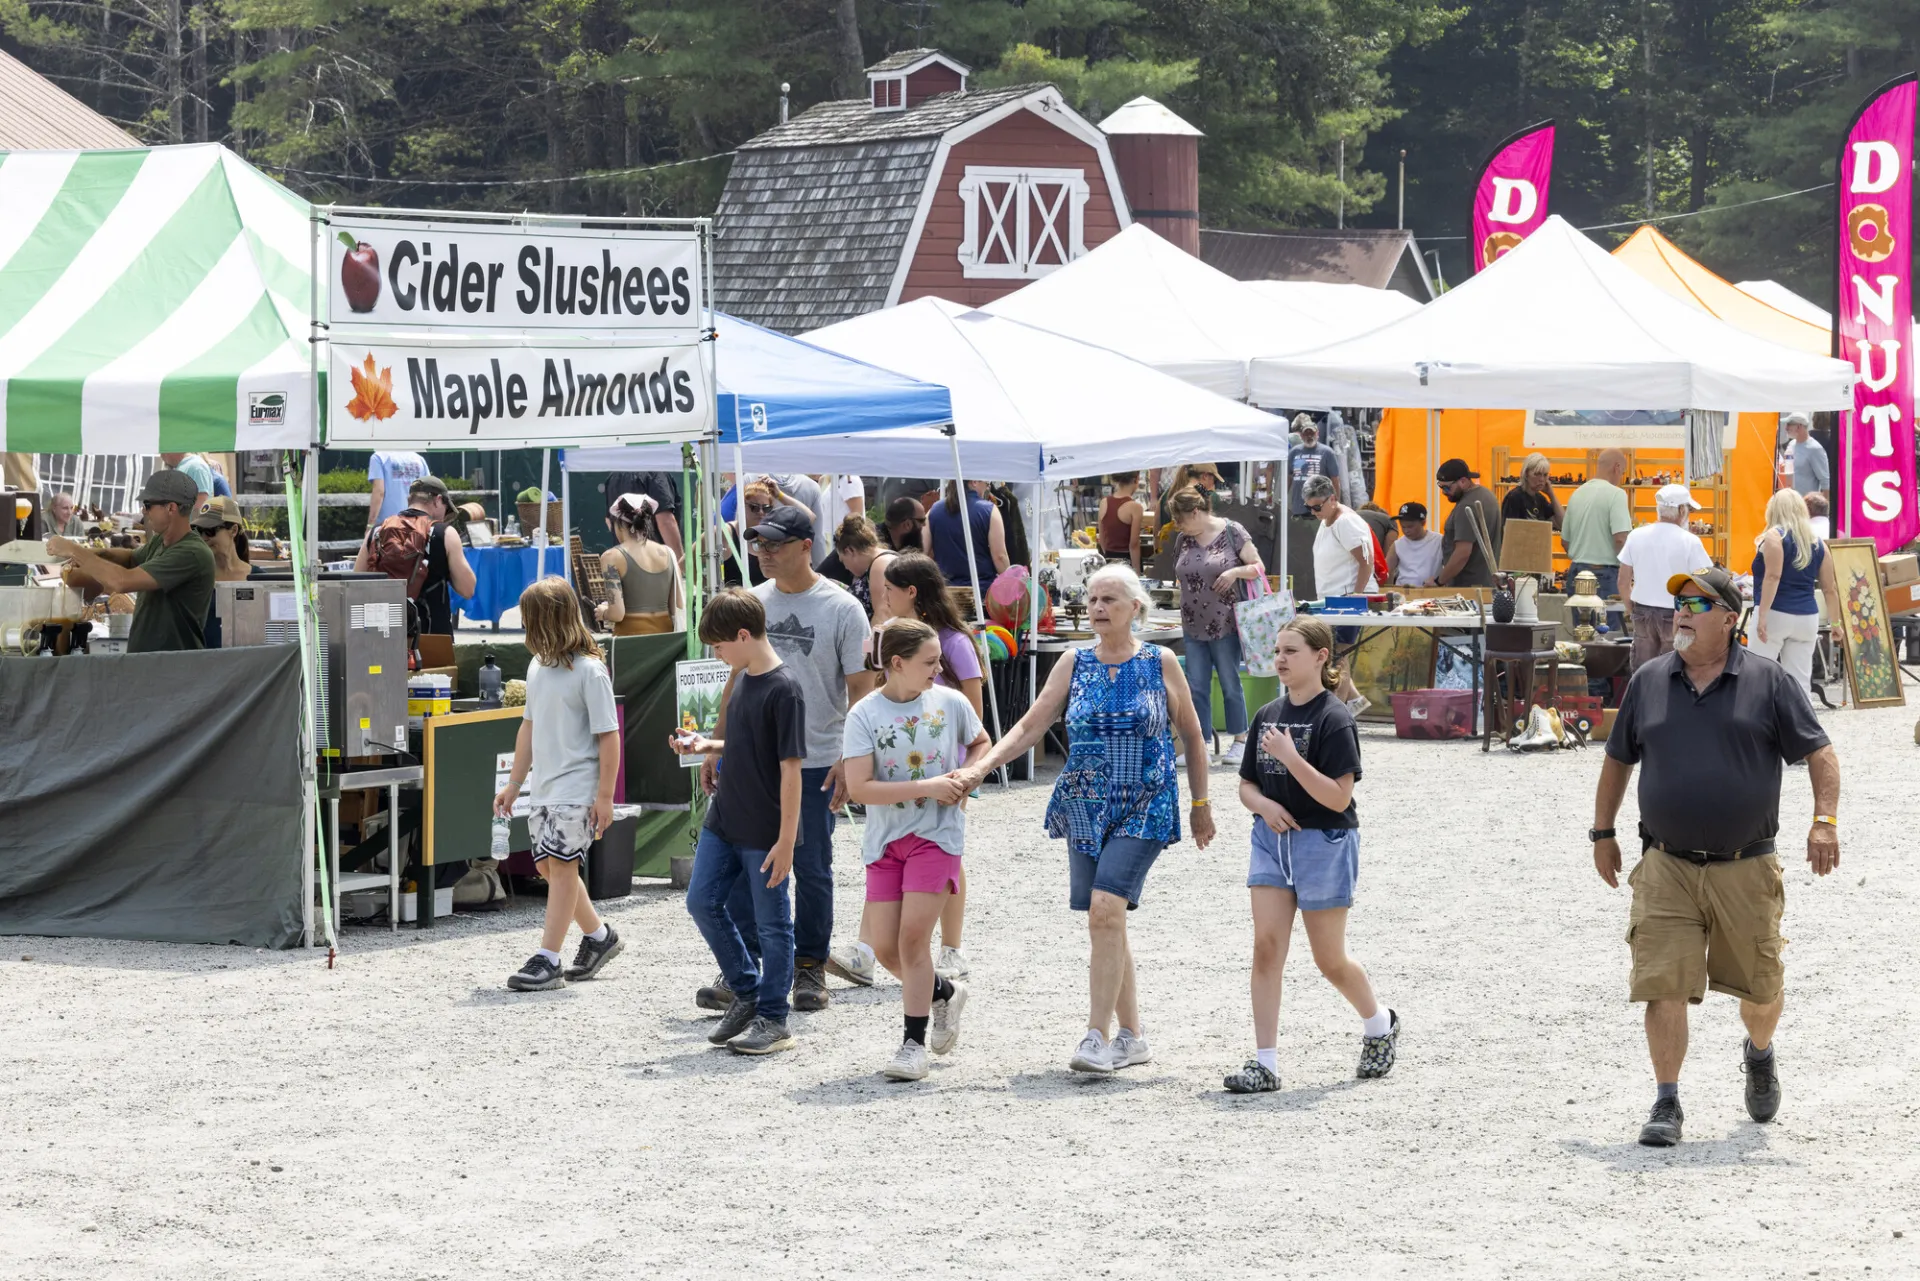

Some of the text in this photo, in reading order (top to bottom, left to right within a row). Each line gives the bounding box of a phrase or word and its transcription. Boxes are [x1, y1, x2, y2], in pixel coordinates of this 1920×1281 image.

[389, 240, 691, 315] Cider Slushees
[251, 405, 282, 418] Eurmax
[407, 356, 695, 434] Maple Almonds
[680, 671, 730, 686] FOOD TRUCK FEST
